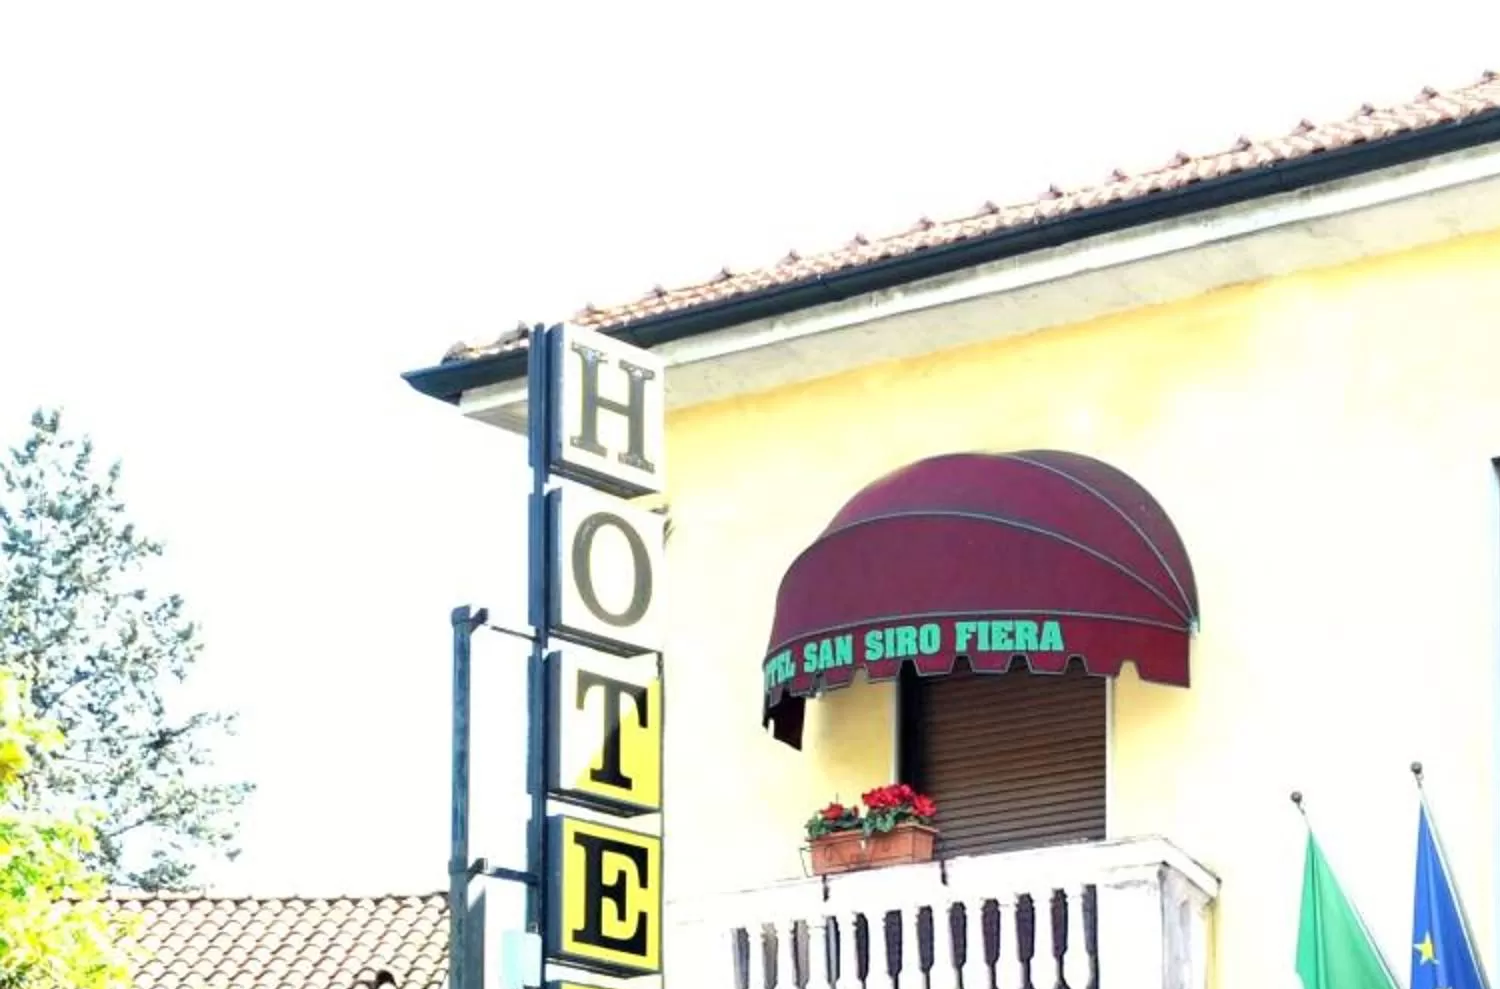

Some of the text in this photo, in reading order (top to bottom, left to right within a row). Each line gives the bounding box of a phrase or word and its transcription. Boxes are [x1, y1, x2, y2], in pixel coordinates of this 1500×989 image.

[765, 620, 1064, 691] TEL SAN SIRO FIERA
